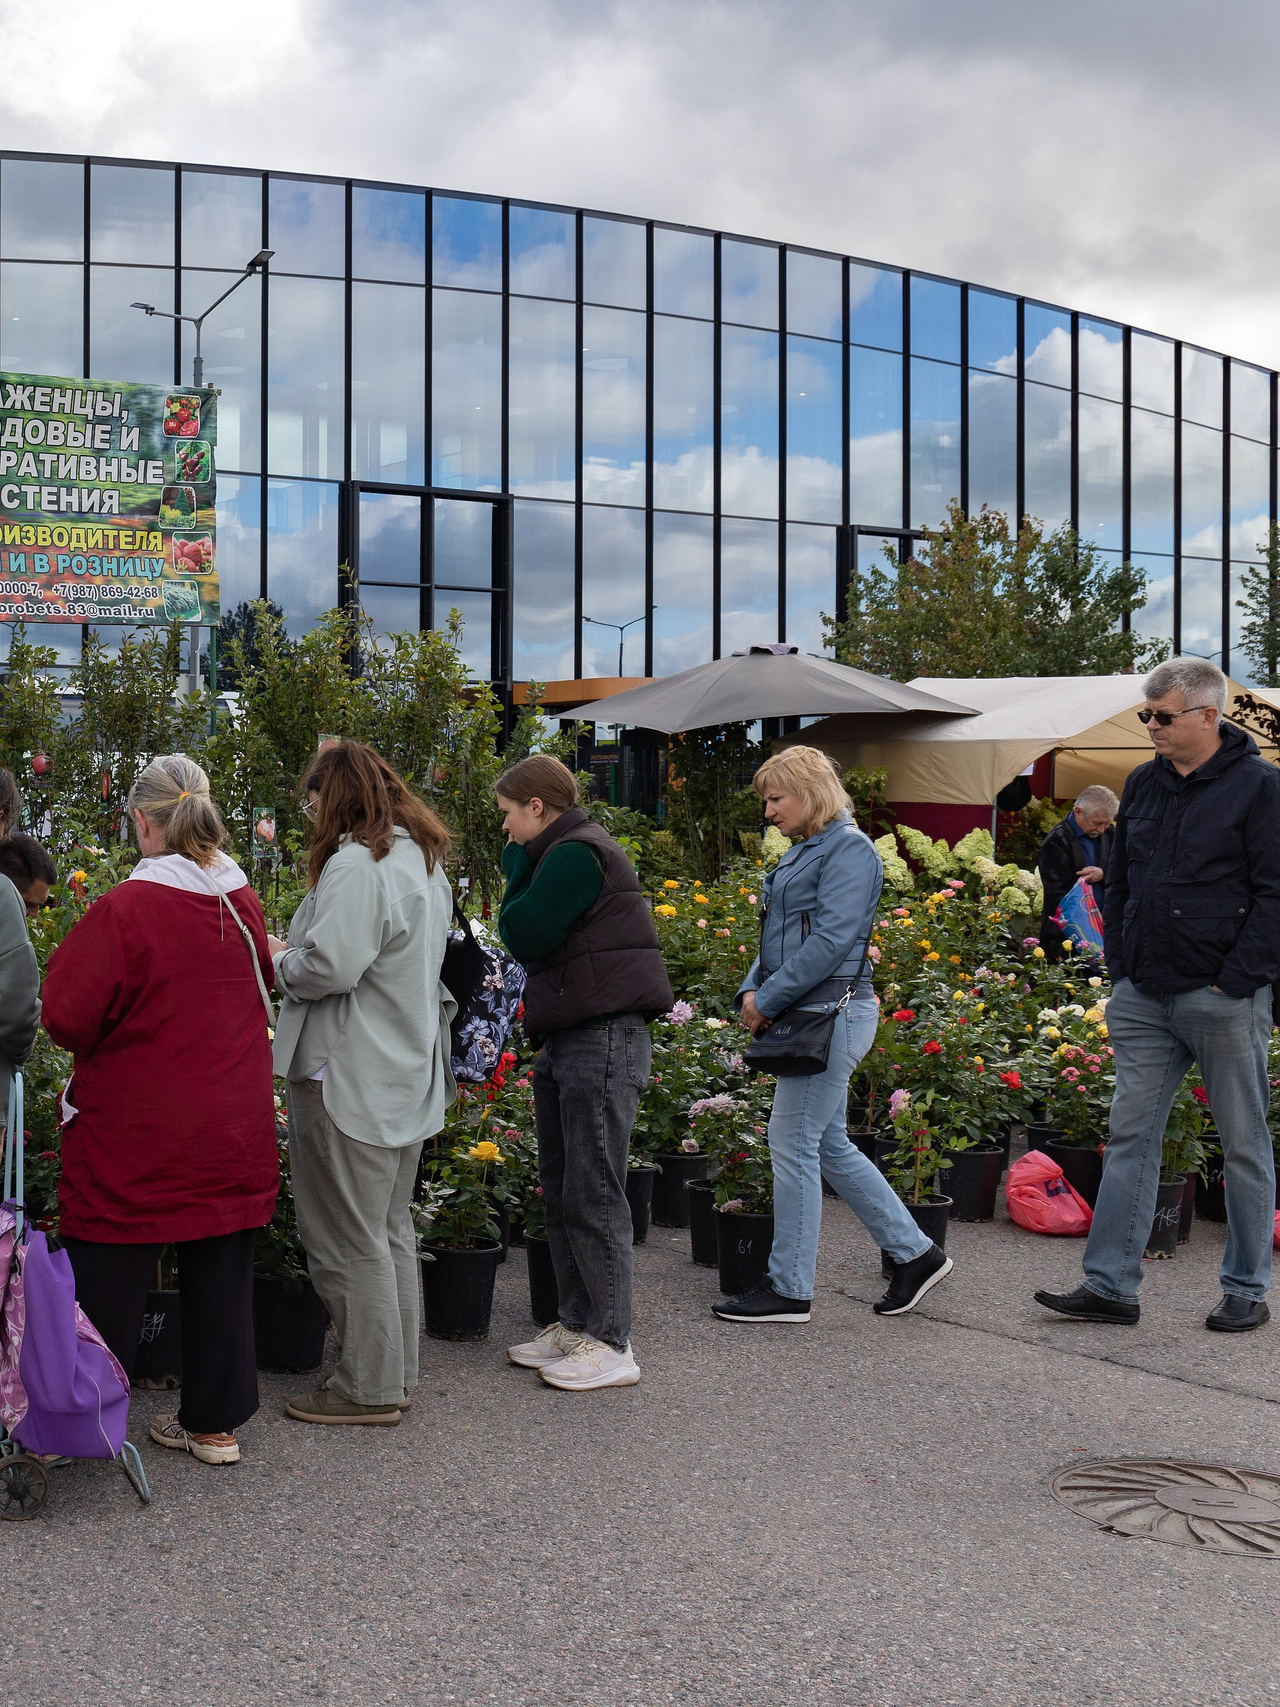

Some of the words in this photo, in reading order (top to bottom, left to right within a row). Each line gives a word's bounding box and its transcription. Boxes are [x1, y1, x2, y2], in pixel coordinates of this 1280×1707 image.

[119, 426, 140, 452] И
[9, 553, 26, 574] И
[34, 554, 50, 575] В
[57, 555, 165, 581] РОЗНИЦУ
[52, 583, 99, 601] +7(987)
[101, 584, 159, 600] 869-42-68
